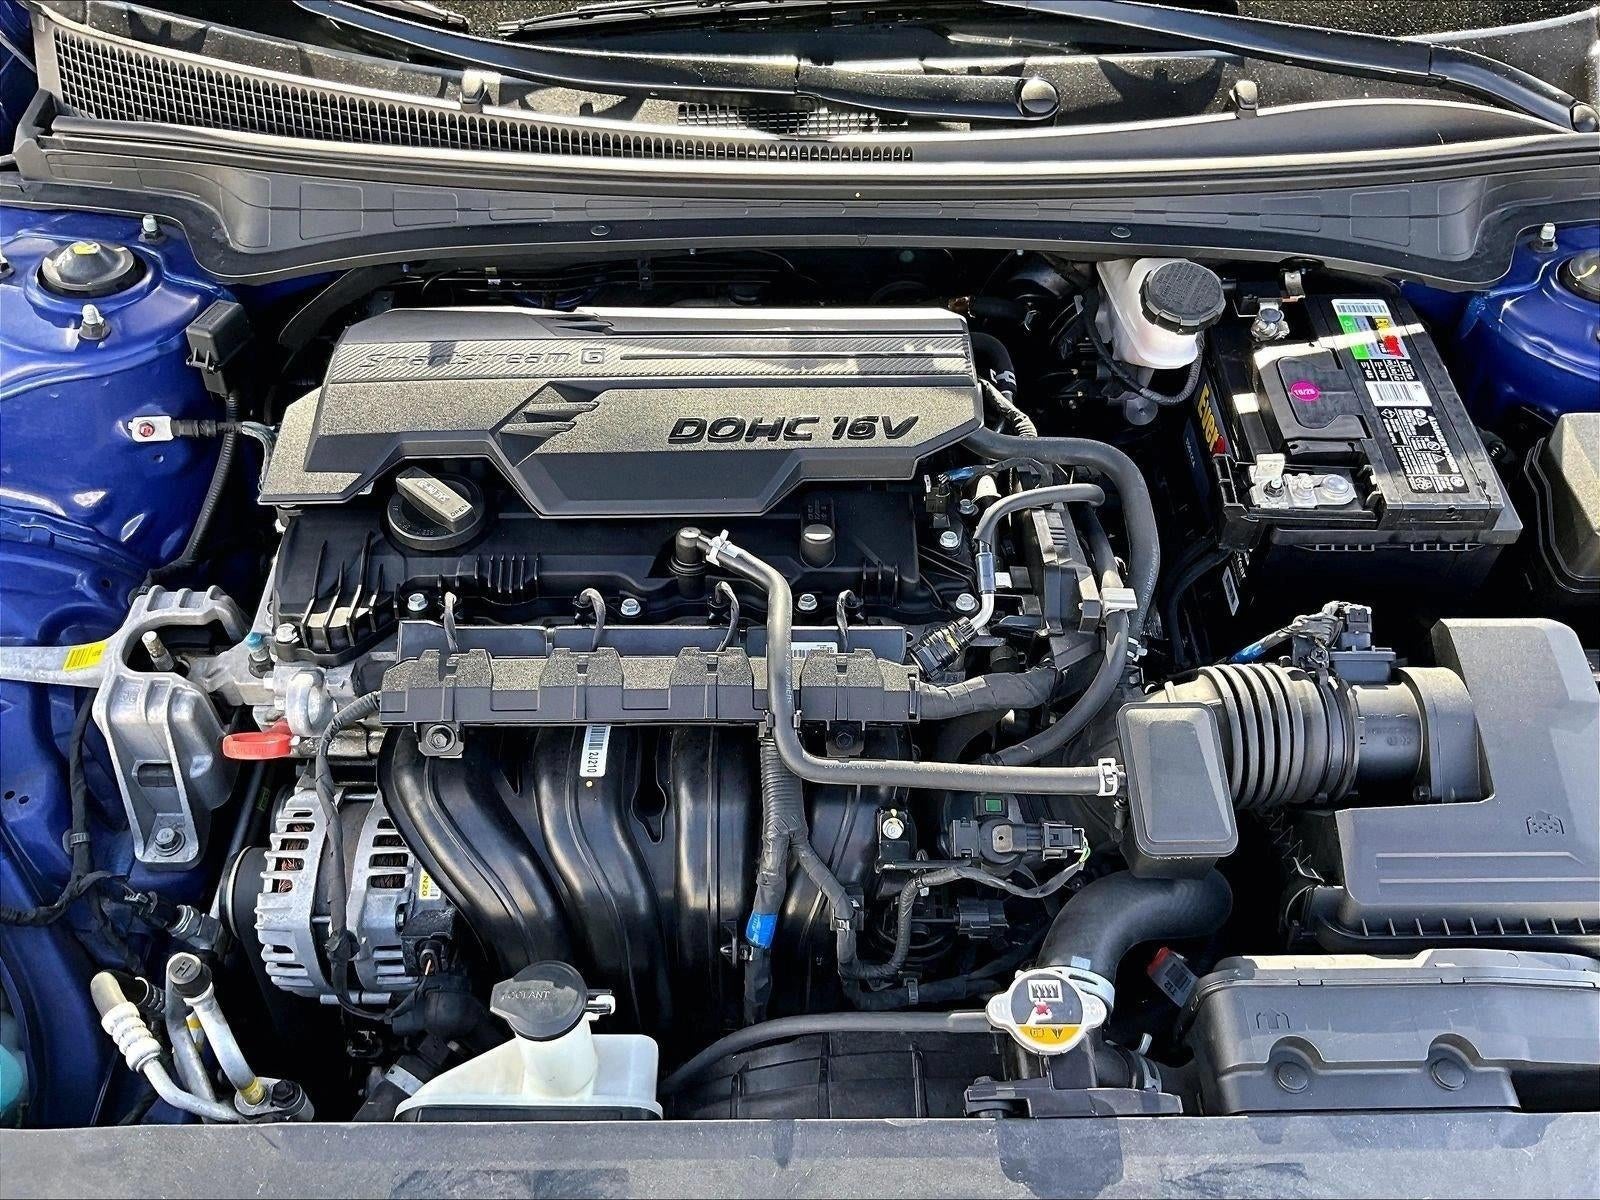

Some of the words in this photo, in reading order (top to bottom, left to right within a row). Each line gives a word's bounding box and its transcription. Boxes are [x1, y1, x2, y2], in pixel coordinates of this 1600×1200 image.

[668, 415, 820, 444] DOHC
[832, 415, 919, 440] 16V
[450, 504, 468, 517] OPEN
